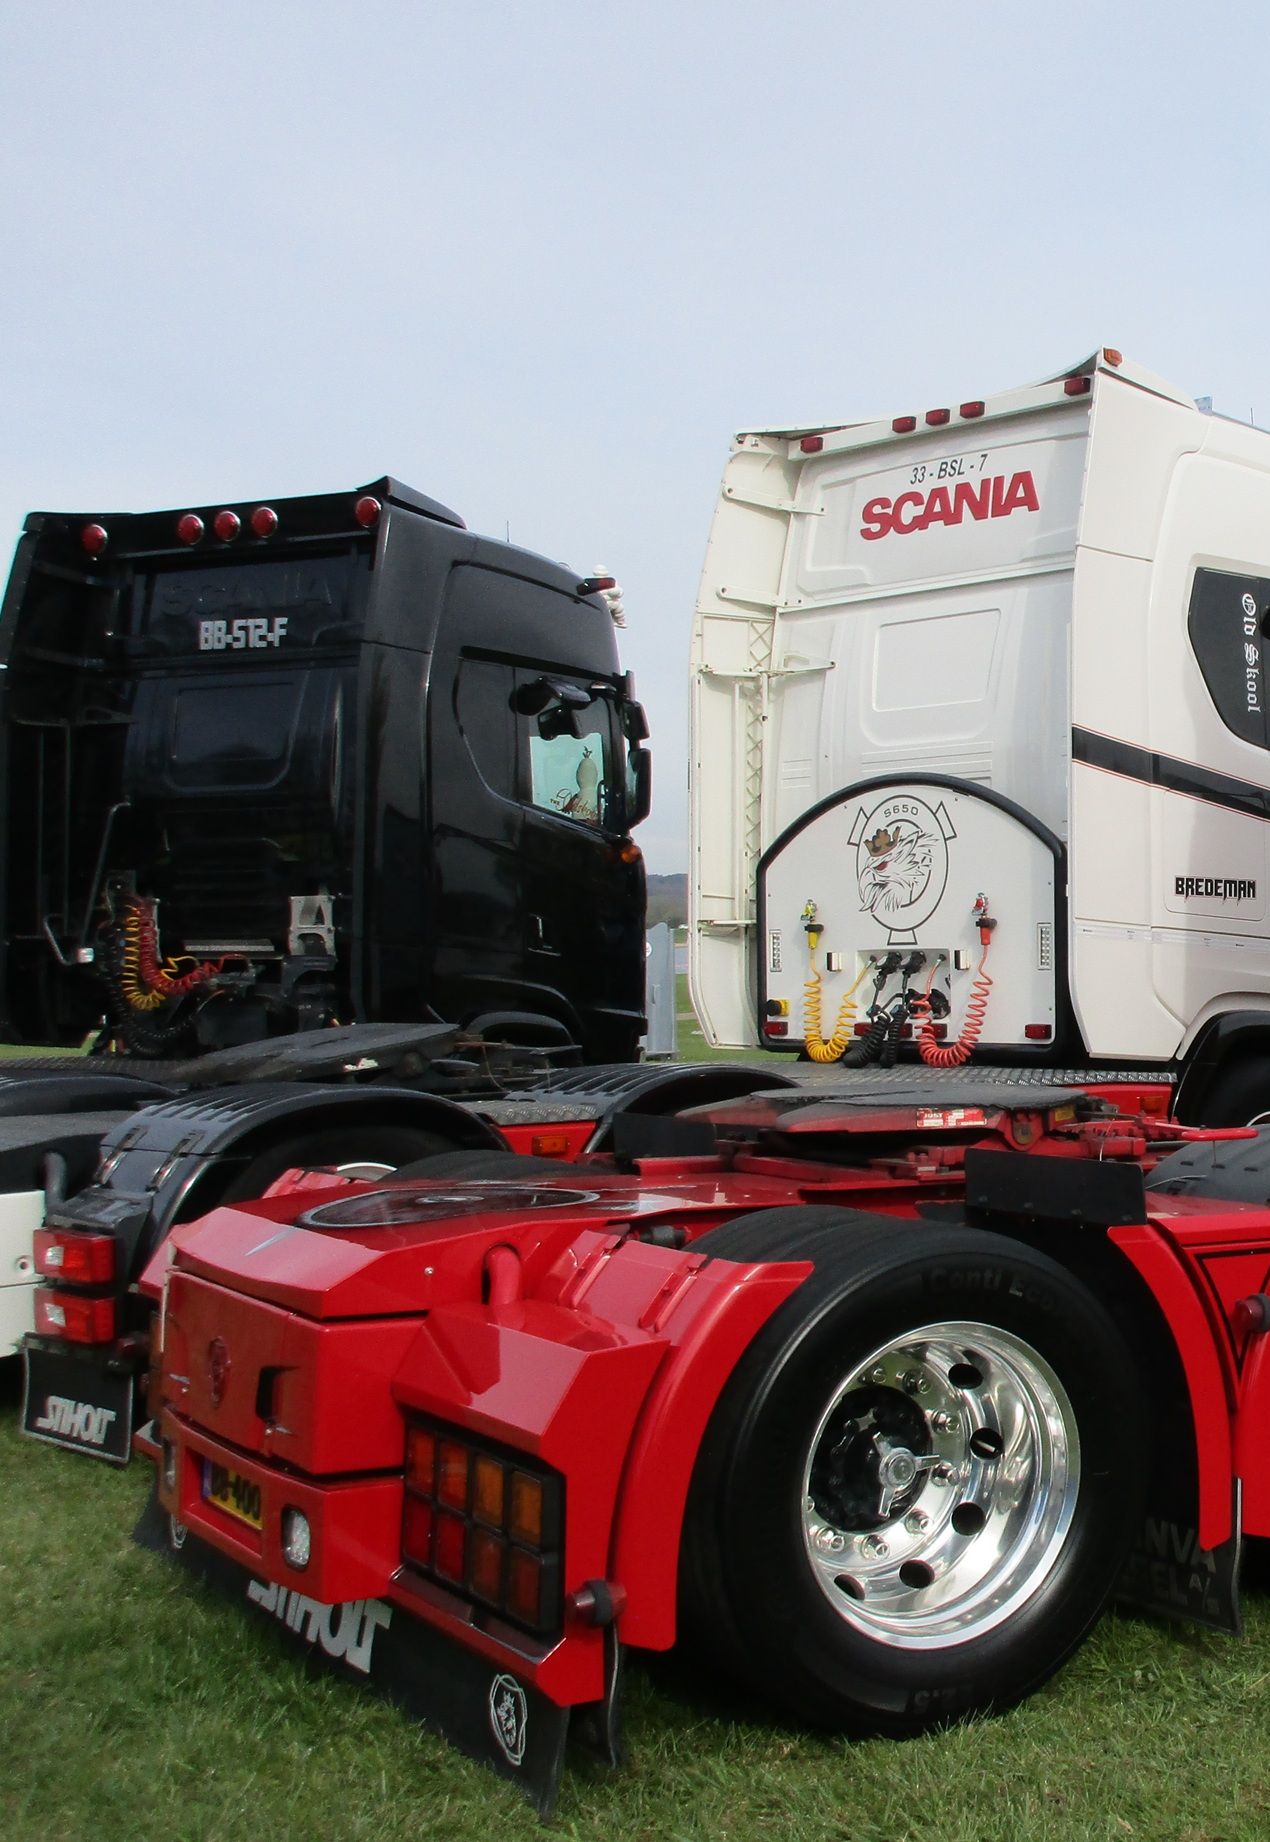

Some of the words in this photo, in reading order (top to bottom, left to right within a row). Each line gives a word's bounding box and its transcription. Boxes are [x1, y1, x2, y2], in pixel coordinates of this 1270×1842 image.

[910, 465, 927, 485] 33
[937, 458, 965, 480] BSL
[979, 453, 988, 472] 7
[860, 470, 1040, 541] SCANIA
[1241, 593, 1257, 636] Old
[199, 617, 289, 651] BB-512-F
[1244, 642, 1262, 712] Skool
[883, 804, 919, 818] S650
[1175, 877, 1256, 901] BREDEMAN
